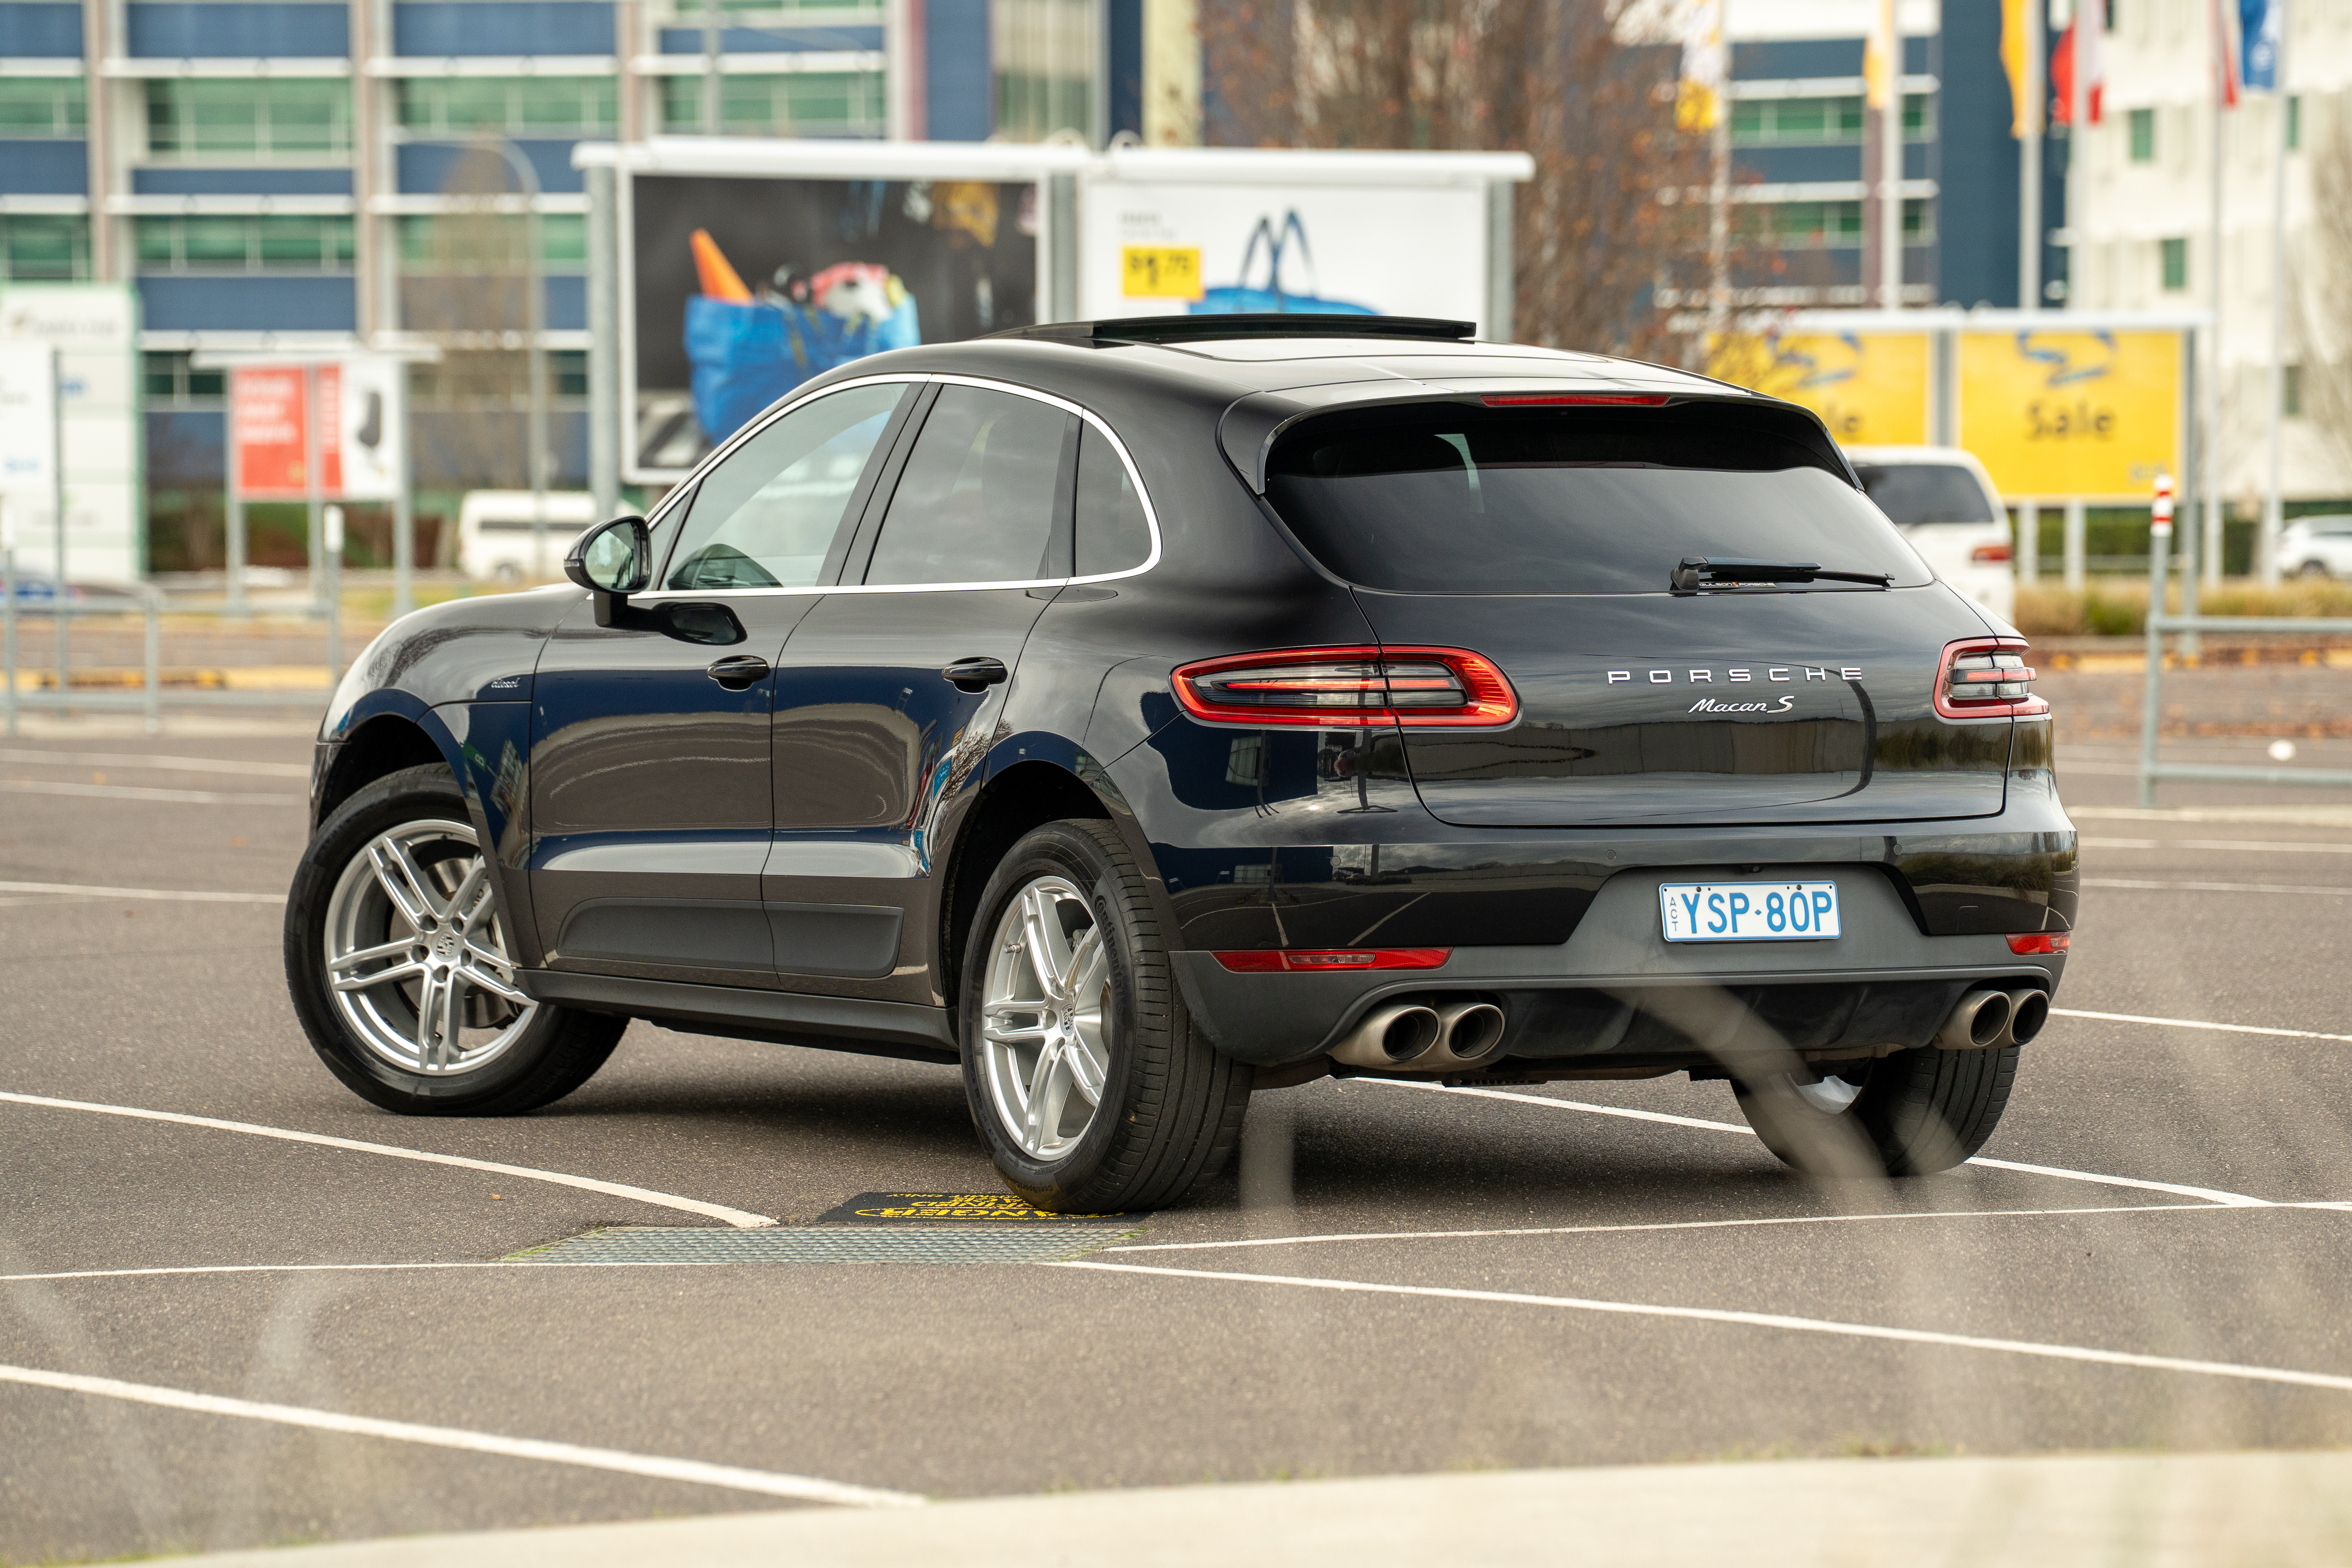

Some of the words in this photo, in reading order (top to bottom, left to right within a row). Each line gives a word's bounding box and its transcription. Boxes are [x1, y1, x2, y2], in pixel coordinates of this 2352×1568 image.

[2024, 400, 2115, 441] Sale
[1607, 667, 1862, 684] PORSCHE
[1688, 698, 1767, 713] Macan
[1767, 695, 1795, 713] S
[1669, 896, 1678, 931] ACT
[1094, 895, 1124, 997] Continental
[879, 1208, 1059, 1217] ANGER
